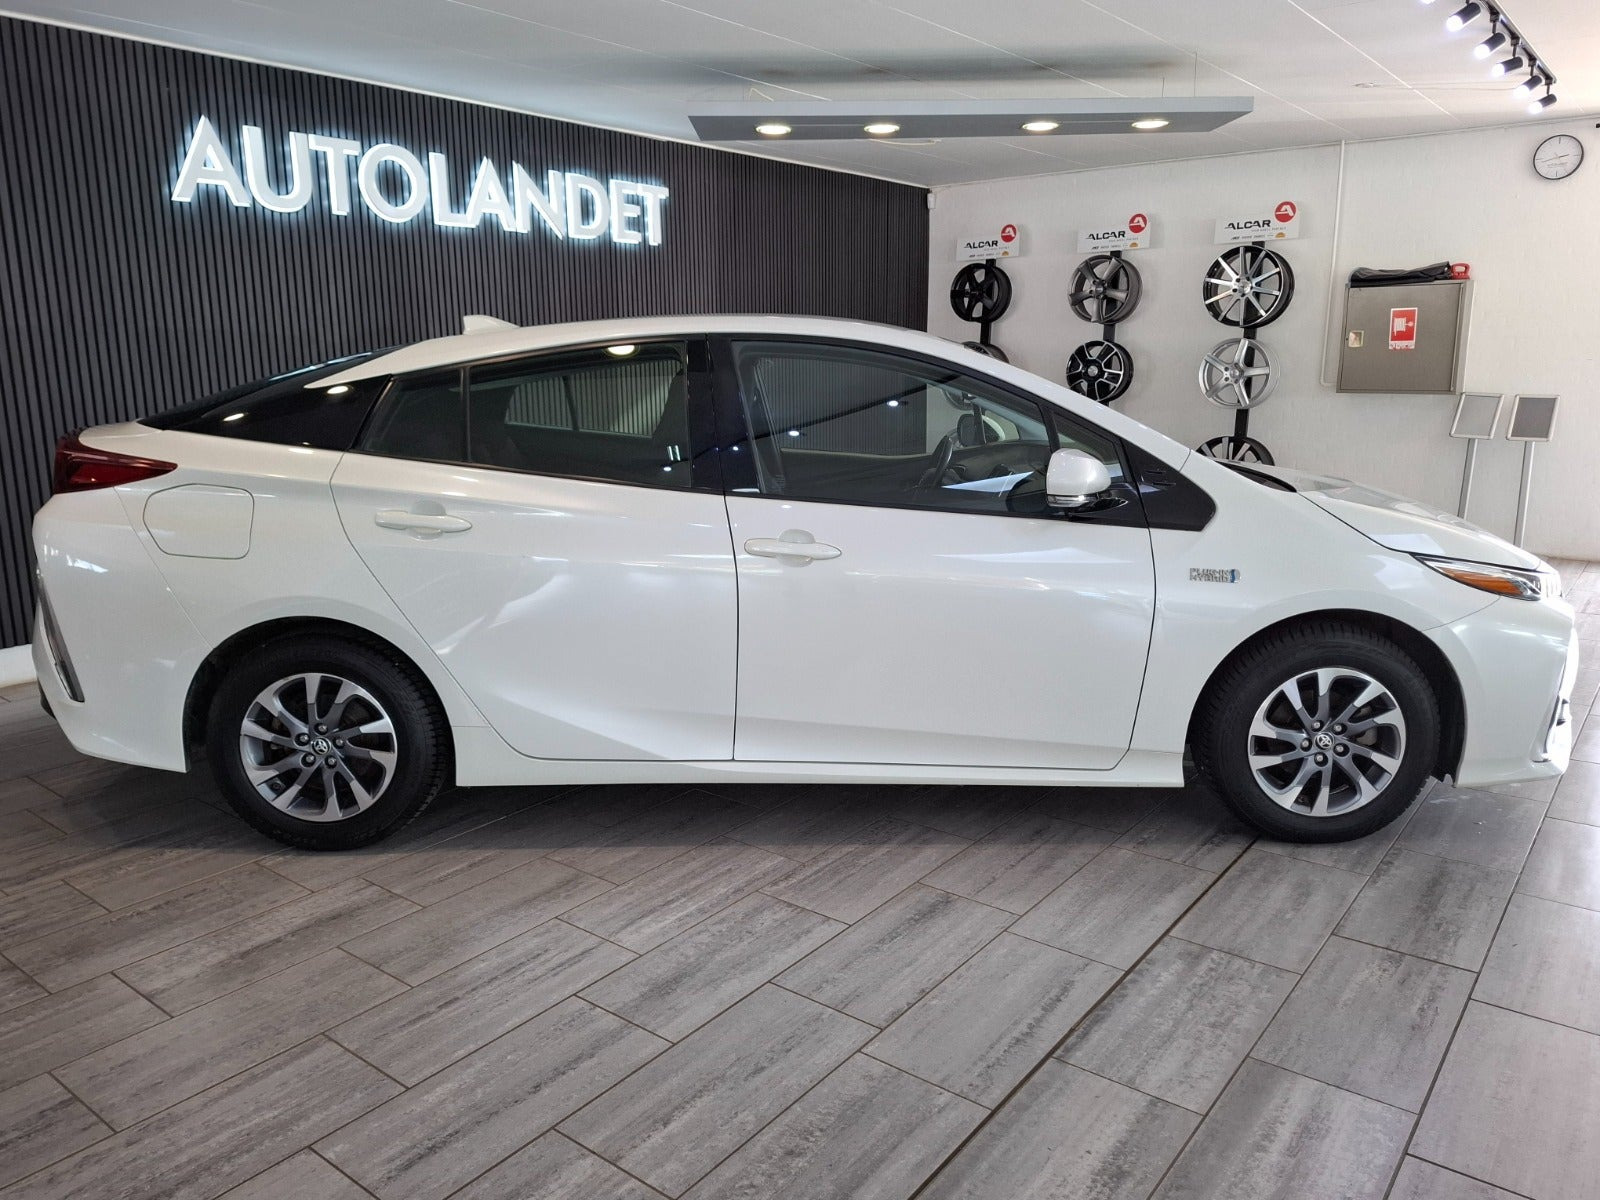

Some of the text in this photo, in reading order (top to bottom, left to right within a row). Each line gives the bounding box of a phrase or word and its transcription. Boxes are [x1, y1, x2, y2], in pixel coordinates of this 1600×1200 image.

[171, 114, 669, 246] AUTOLANDET
[1224, 219, 1271, 230] ALCAR
[1085, 230, 1126, 241] ALCAR
[964, 240, 998, 250] ALCAR
